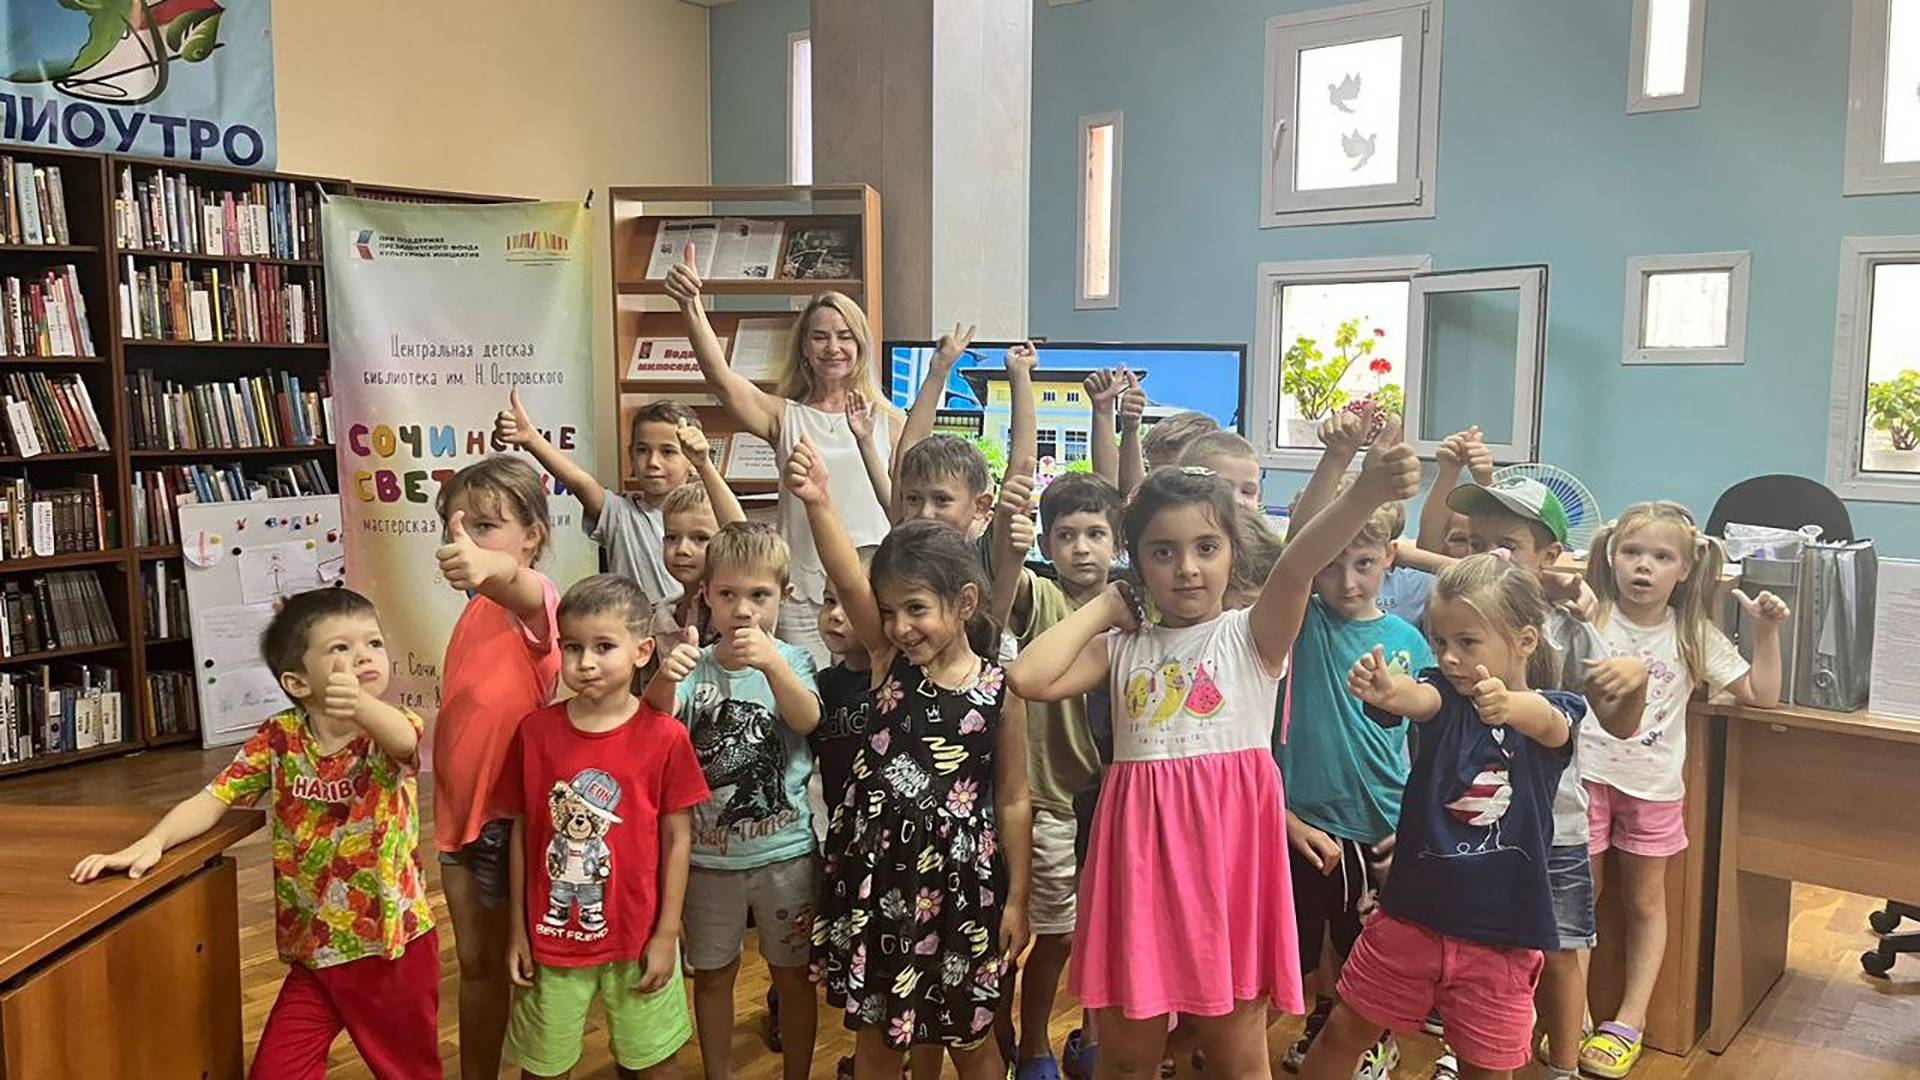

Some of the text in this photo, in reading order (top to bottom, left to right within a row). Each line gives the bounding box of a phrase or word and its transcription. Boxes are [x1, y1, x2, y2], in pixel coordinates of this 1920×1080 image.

[390, 335, 535, 360] Центральная детская
[363, 370, 437, 386] библиотека
[491, 361, 564, 385] Островского
[363, 519, 437, 537] мастерская
[535, 923, 609, 942] BEST FRIEND
